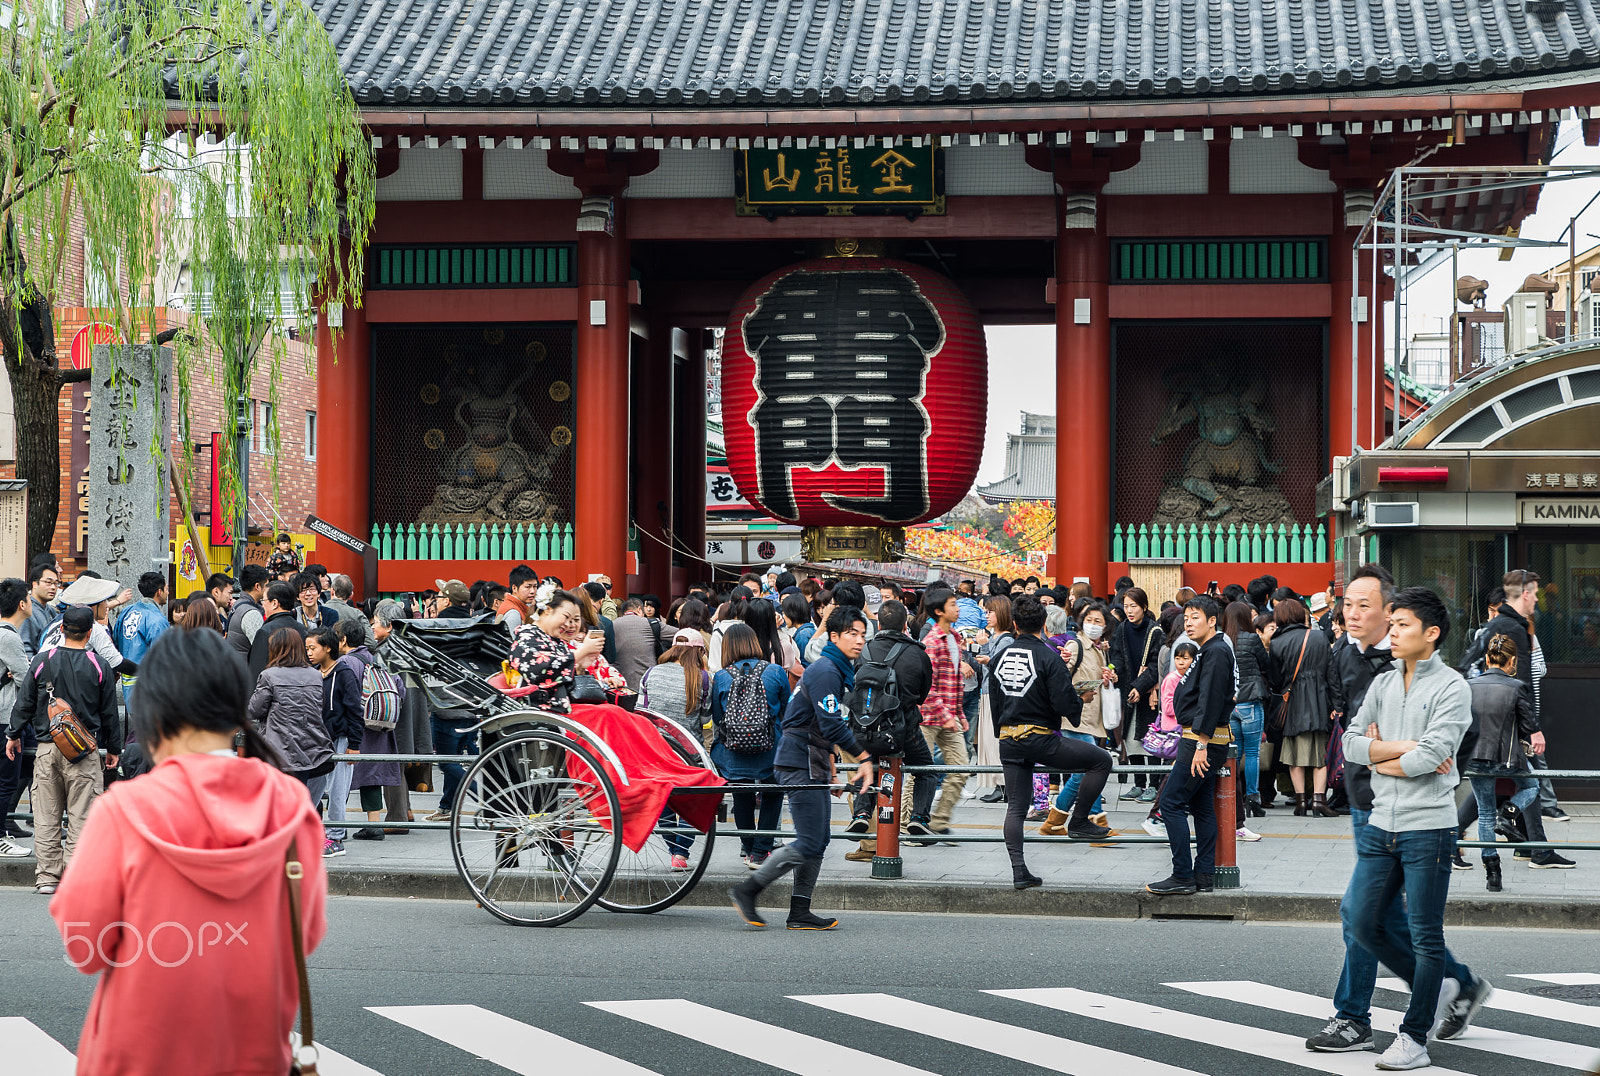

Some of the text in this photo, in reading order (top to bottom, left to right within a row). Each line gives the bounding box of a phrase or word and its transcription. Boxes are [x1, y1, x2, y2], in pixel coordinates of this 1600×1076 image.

[741, 267, 946, 523] 雷門
[1526, 473, 1598, 488] 浅草警察
[1534, 505, 1600, 519] KAMINA
[350, 538, 365, 549] GATE
